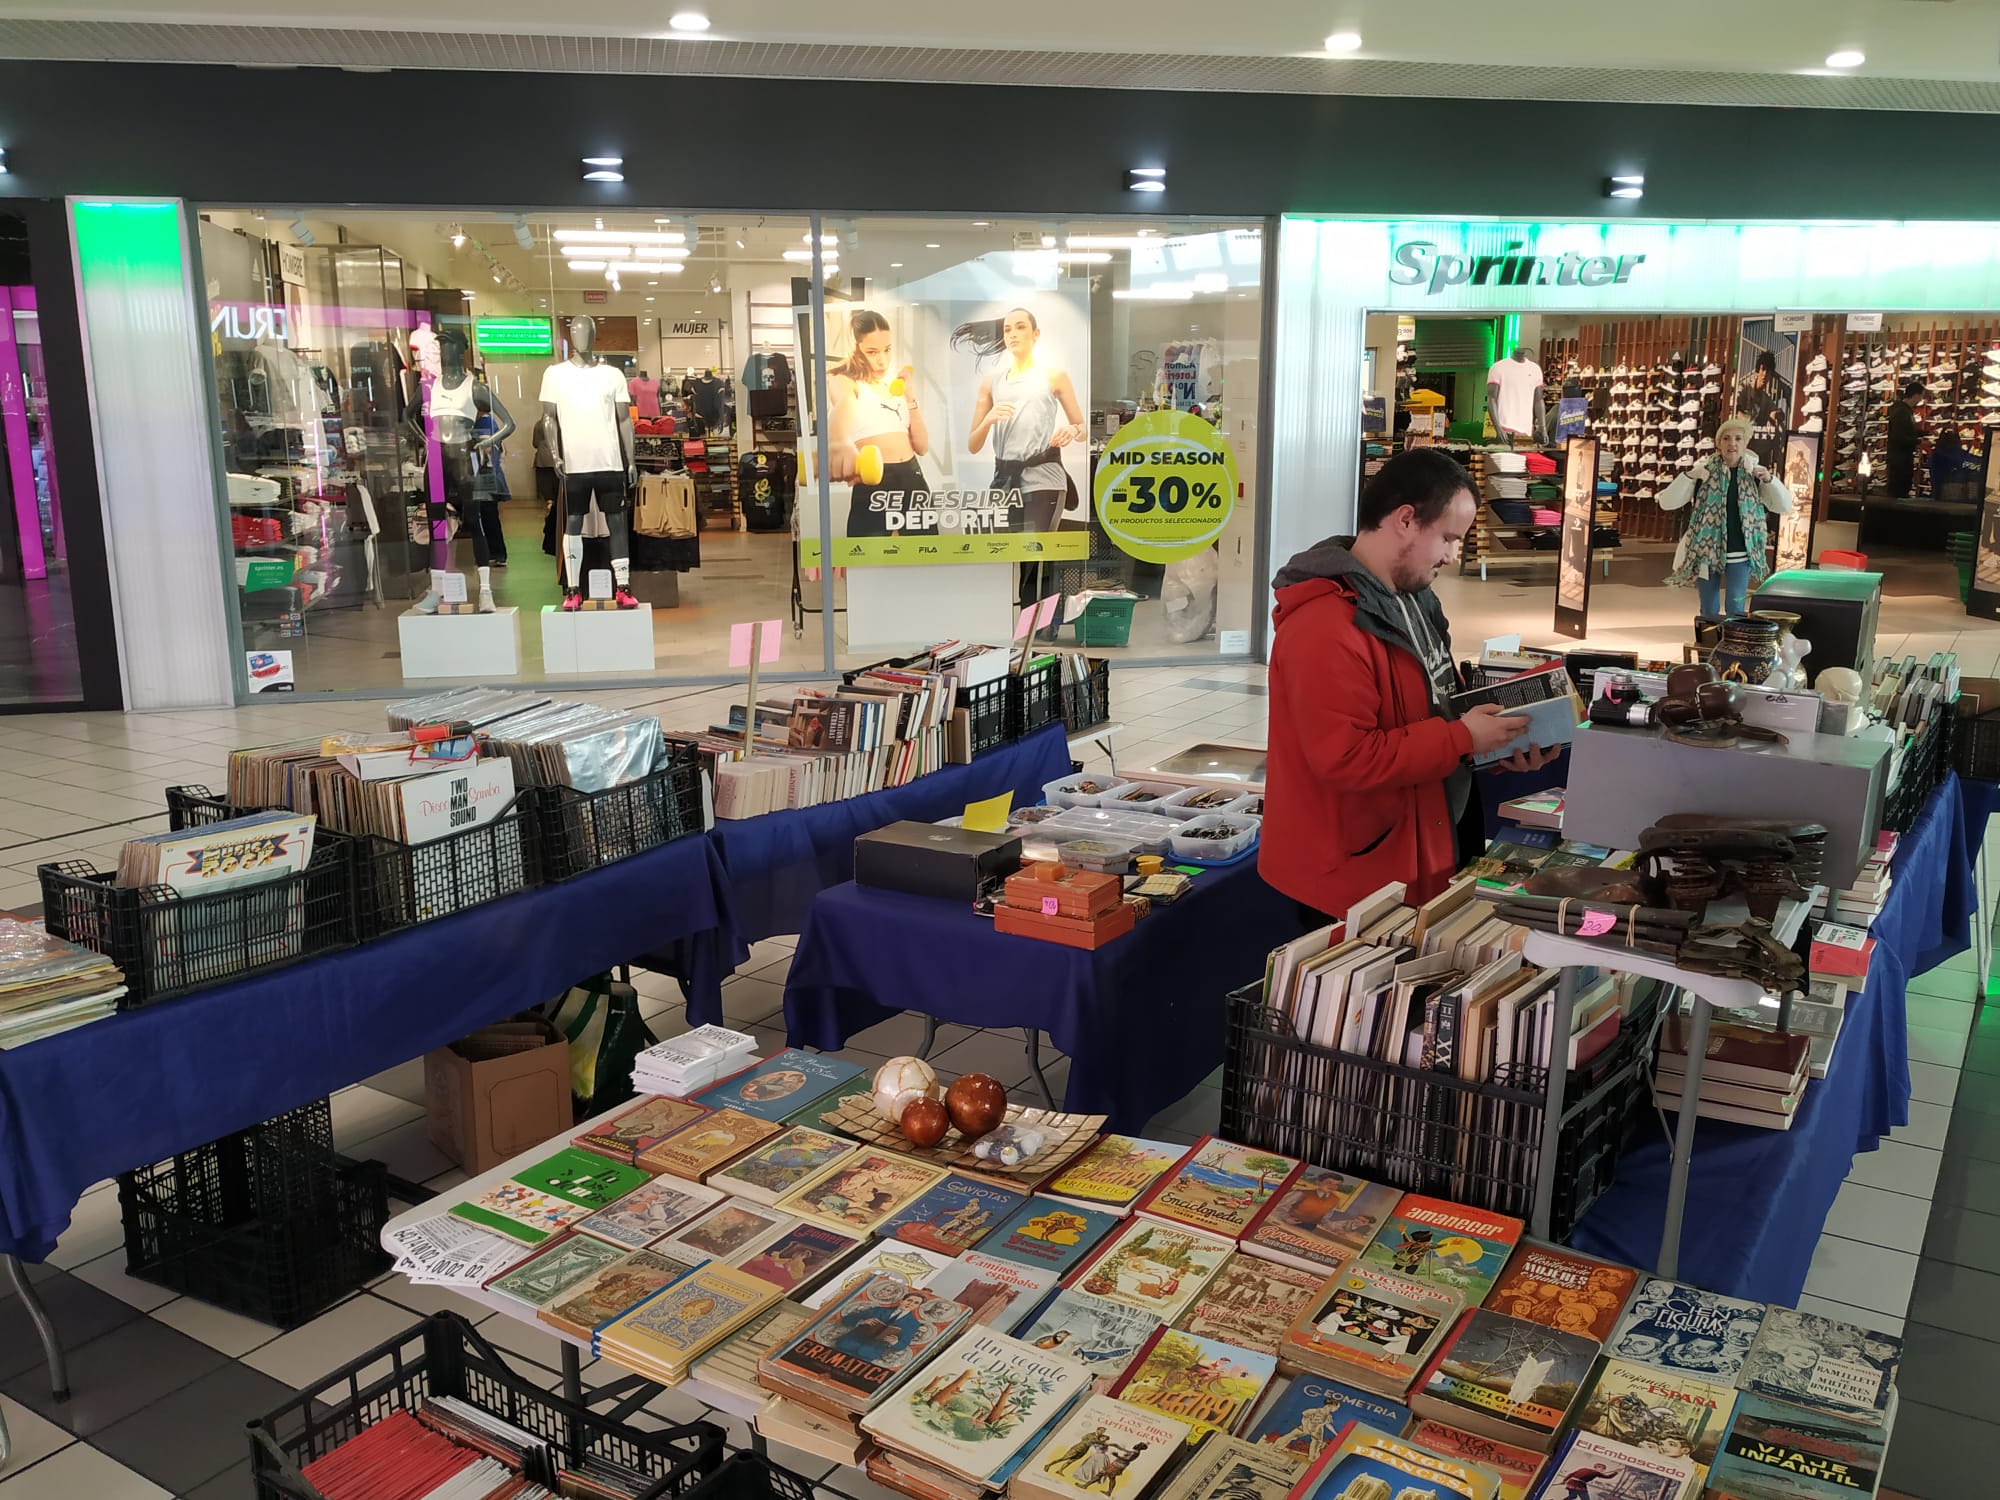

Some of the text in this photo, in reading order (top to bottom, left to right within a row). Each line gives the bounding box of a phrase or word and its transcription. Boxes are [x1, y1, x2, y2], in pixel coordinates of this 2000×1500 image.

[1389, 241, 1646, 295] Sprinter
[672, 323, 708, 335] MUJER
[1110, 451, 1224, 465] MID SEASON
[869, 488, 1023, 511] SE RESPIRA
[1112, 476, 1221, 513] -30%
[885, 508, 1009, 531] DEPORTE
[918, 546, 938, 554] FILA
[829, 711, 837, 740] CERRADAS
[836, 706, 847, 746] HABITACIONES
[450, 777, 469, 794] TWO
[421, 784, 502, 818] Disco MAN Samba
[450, 807, 477, 828] SOUND
[947, 1181, 1011, 1203] GAVIOTAS
[1161, 1192, 1244, 1225] Enciclopedia
[1404, 1206, 1504, 1237] amanecer
[965, 1255, 1018, 1276] Caminos
[1522, 1262, 1588, 1285] MUJERES
[985, 1270, 1040, 1291] españoles
[1657, 1309, 1729, 1332] FIGURAS
[1665, 1300, 1731, 1321] CIEN
[794, 1339, 892, 1384] GRAMATICA
[961, 1351, 1028, 1385] de Dios
[974, 1337, 1069, 1383] Un regalo
[1613, 1368, 1671, 1390] Viajando
[1816, 1365, 1878, 1387] RAMILLETE
[1818, 1376, 1871, 1396] MUJERES
[1303, 1384, 1398, 1420] GEOMETRIA
[1456, 1390, 1492, 1407] TERCER
[1628, 1381, 1718, 1409] por ESPAÑA
[1810, 1383, 1874, 1405] UNIVERSALES
[1119, 1416, 1174, 1439] LOS HIJOS
[1136, 1431, 1168, 1446] GRANT
[1423, 1422, 1499, 1452] SANTOS
[1374, 1438, 1468, 1479] LENGUA
[1458, 1444, 1537, 1473] ESPAÑOLES
[1575, 1438, 1687, 1479] El Emboscado
[1739, 1446, 1862, 1487] INFANTIL
[1758, 1443, 1848, 1475] VIAJE
[1354, 1446, 1475, 1497] FRANCESA
